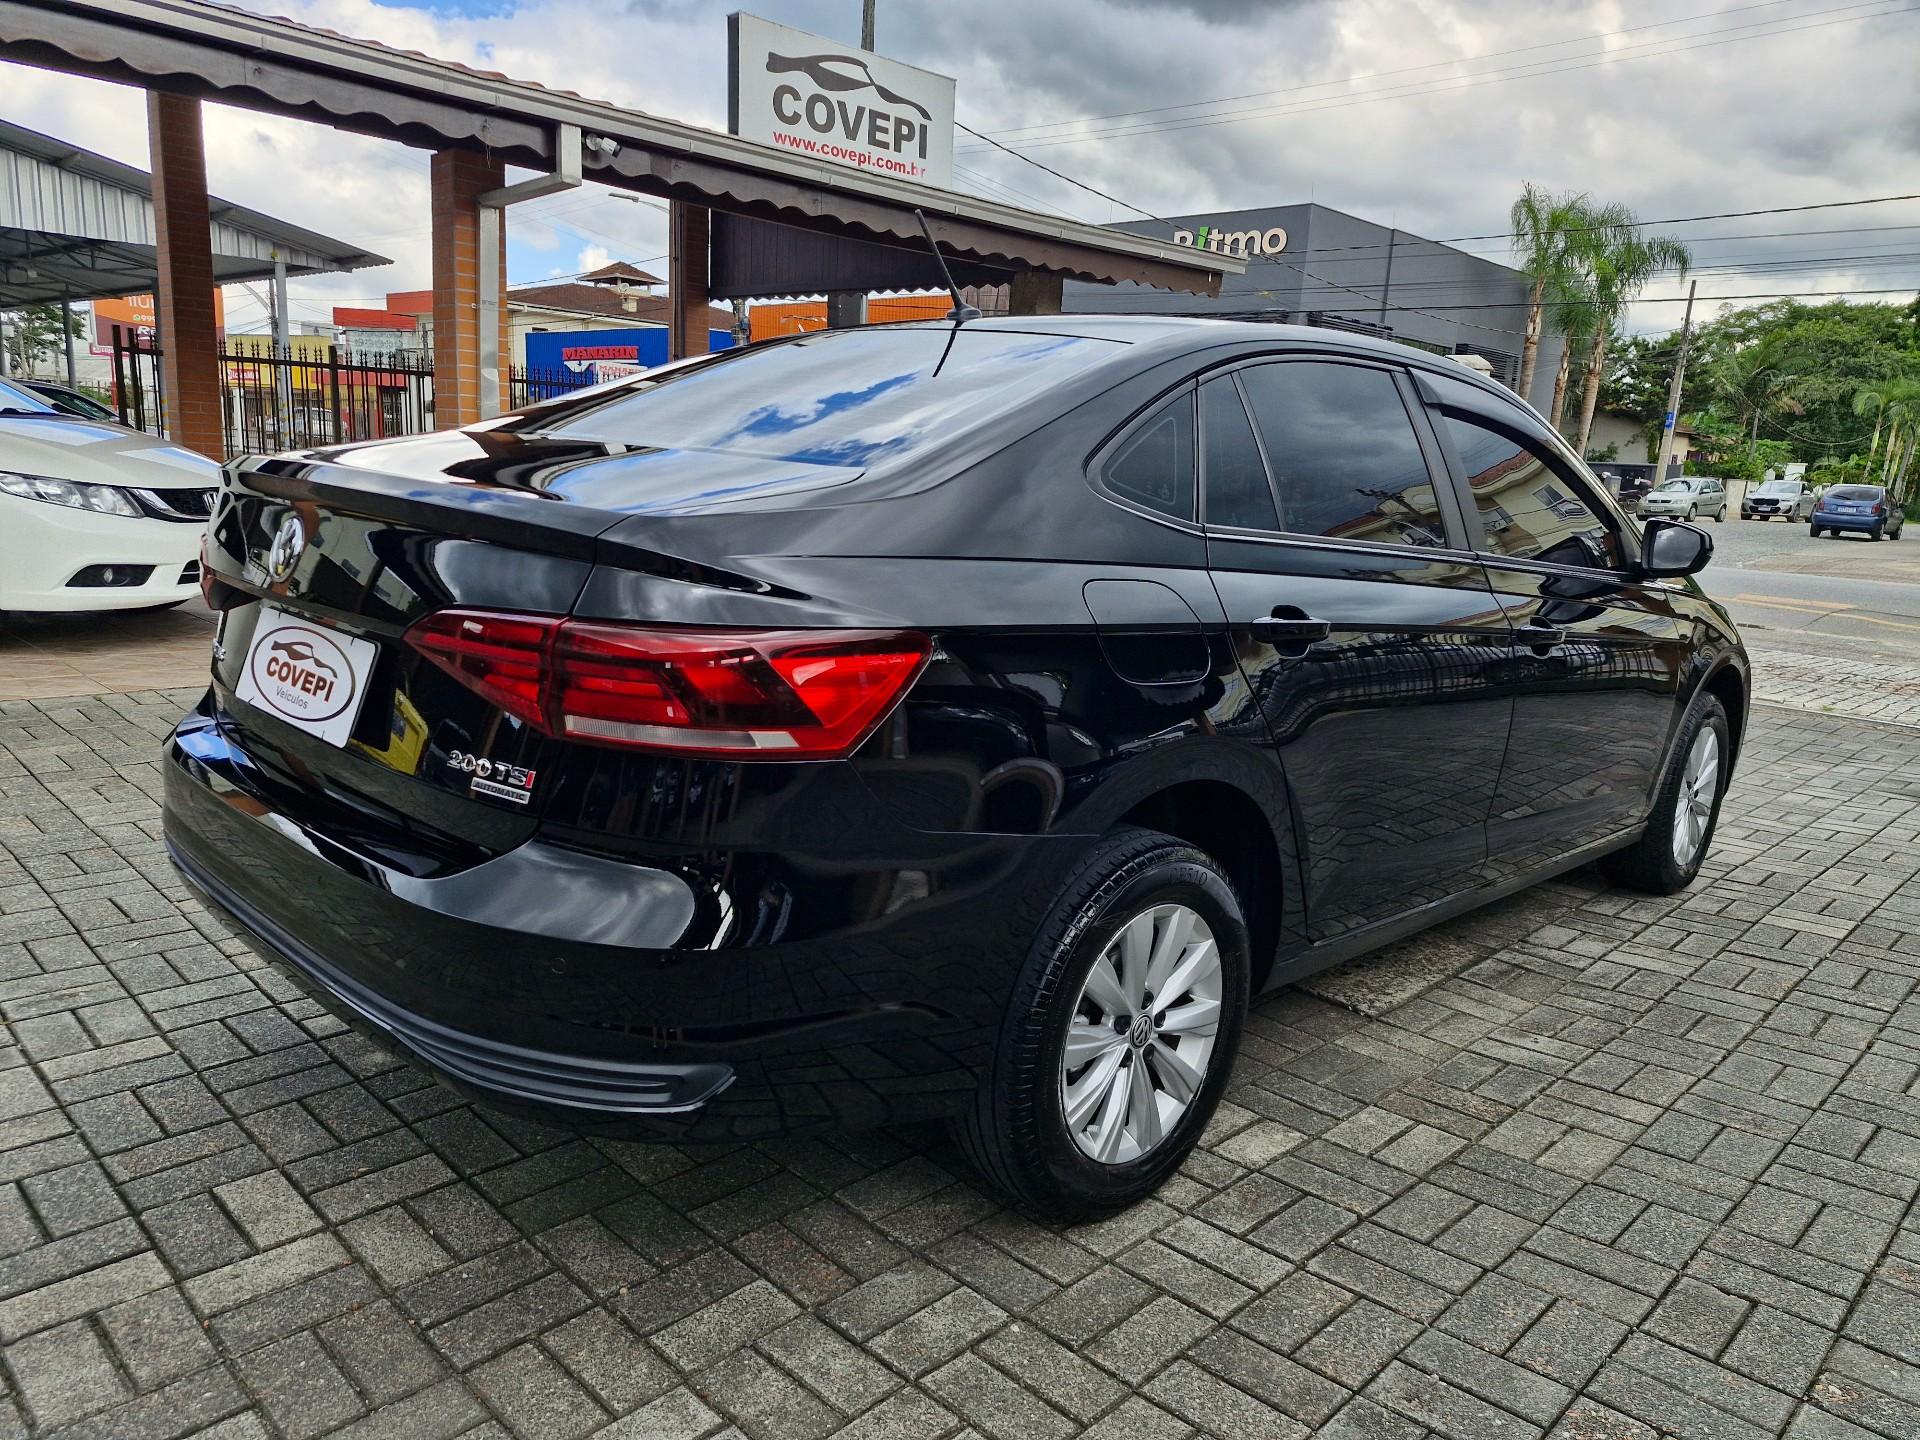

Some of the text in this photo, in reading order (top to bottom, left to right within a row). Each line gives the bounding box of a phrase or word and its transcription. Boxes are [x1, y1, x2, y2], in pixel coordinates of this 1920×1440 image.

[772, 84, 928, 160] COVEPI
[773, 131, 926, 178] www.covepi.com.br
[562, 346, 639, 360] MANARIN
[266, 656, 335, 702] COVEPI
[473, 779, 527, 801] AUTOMATIC
